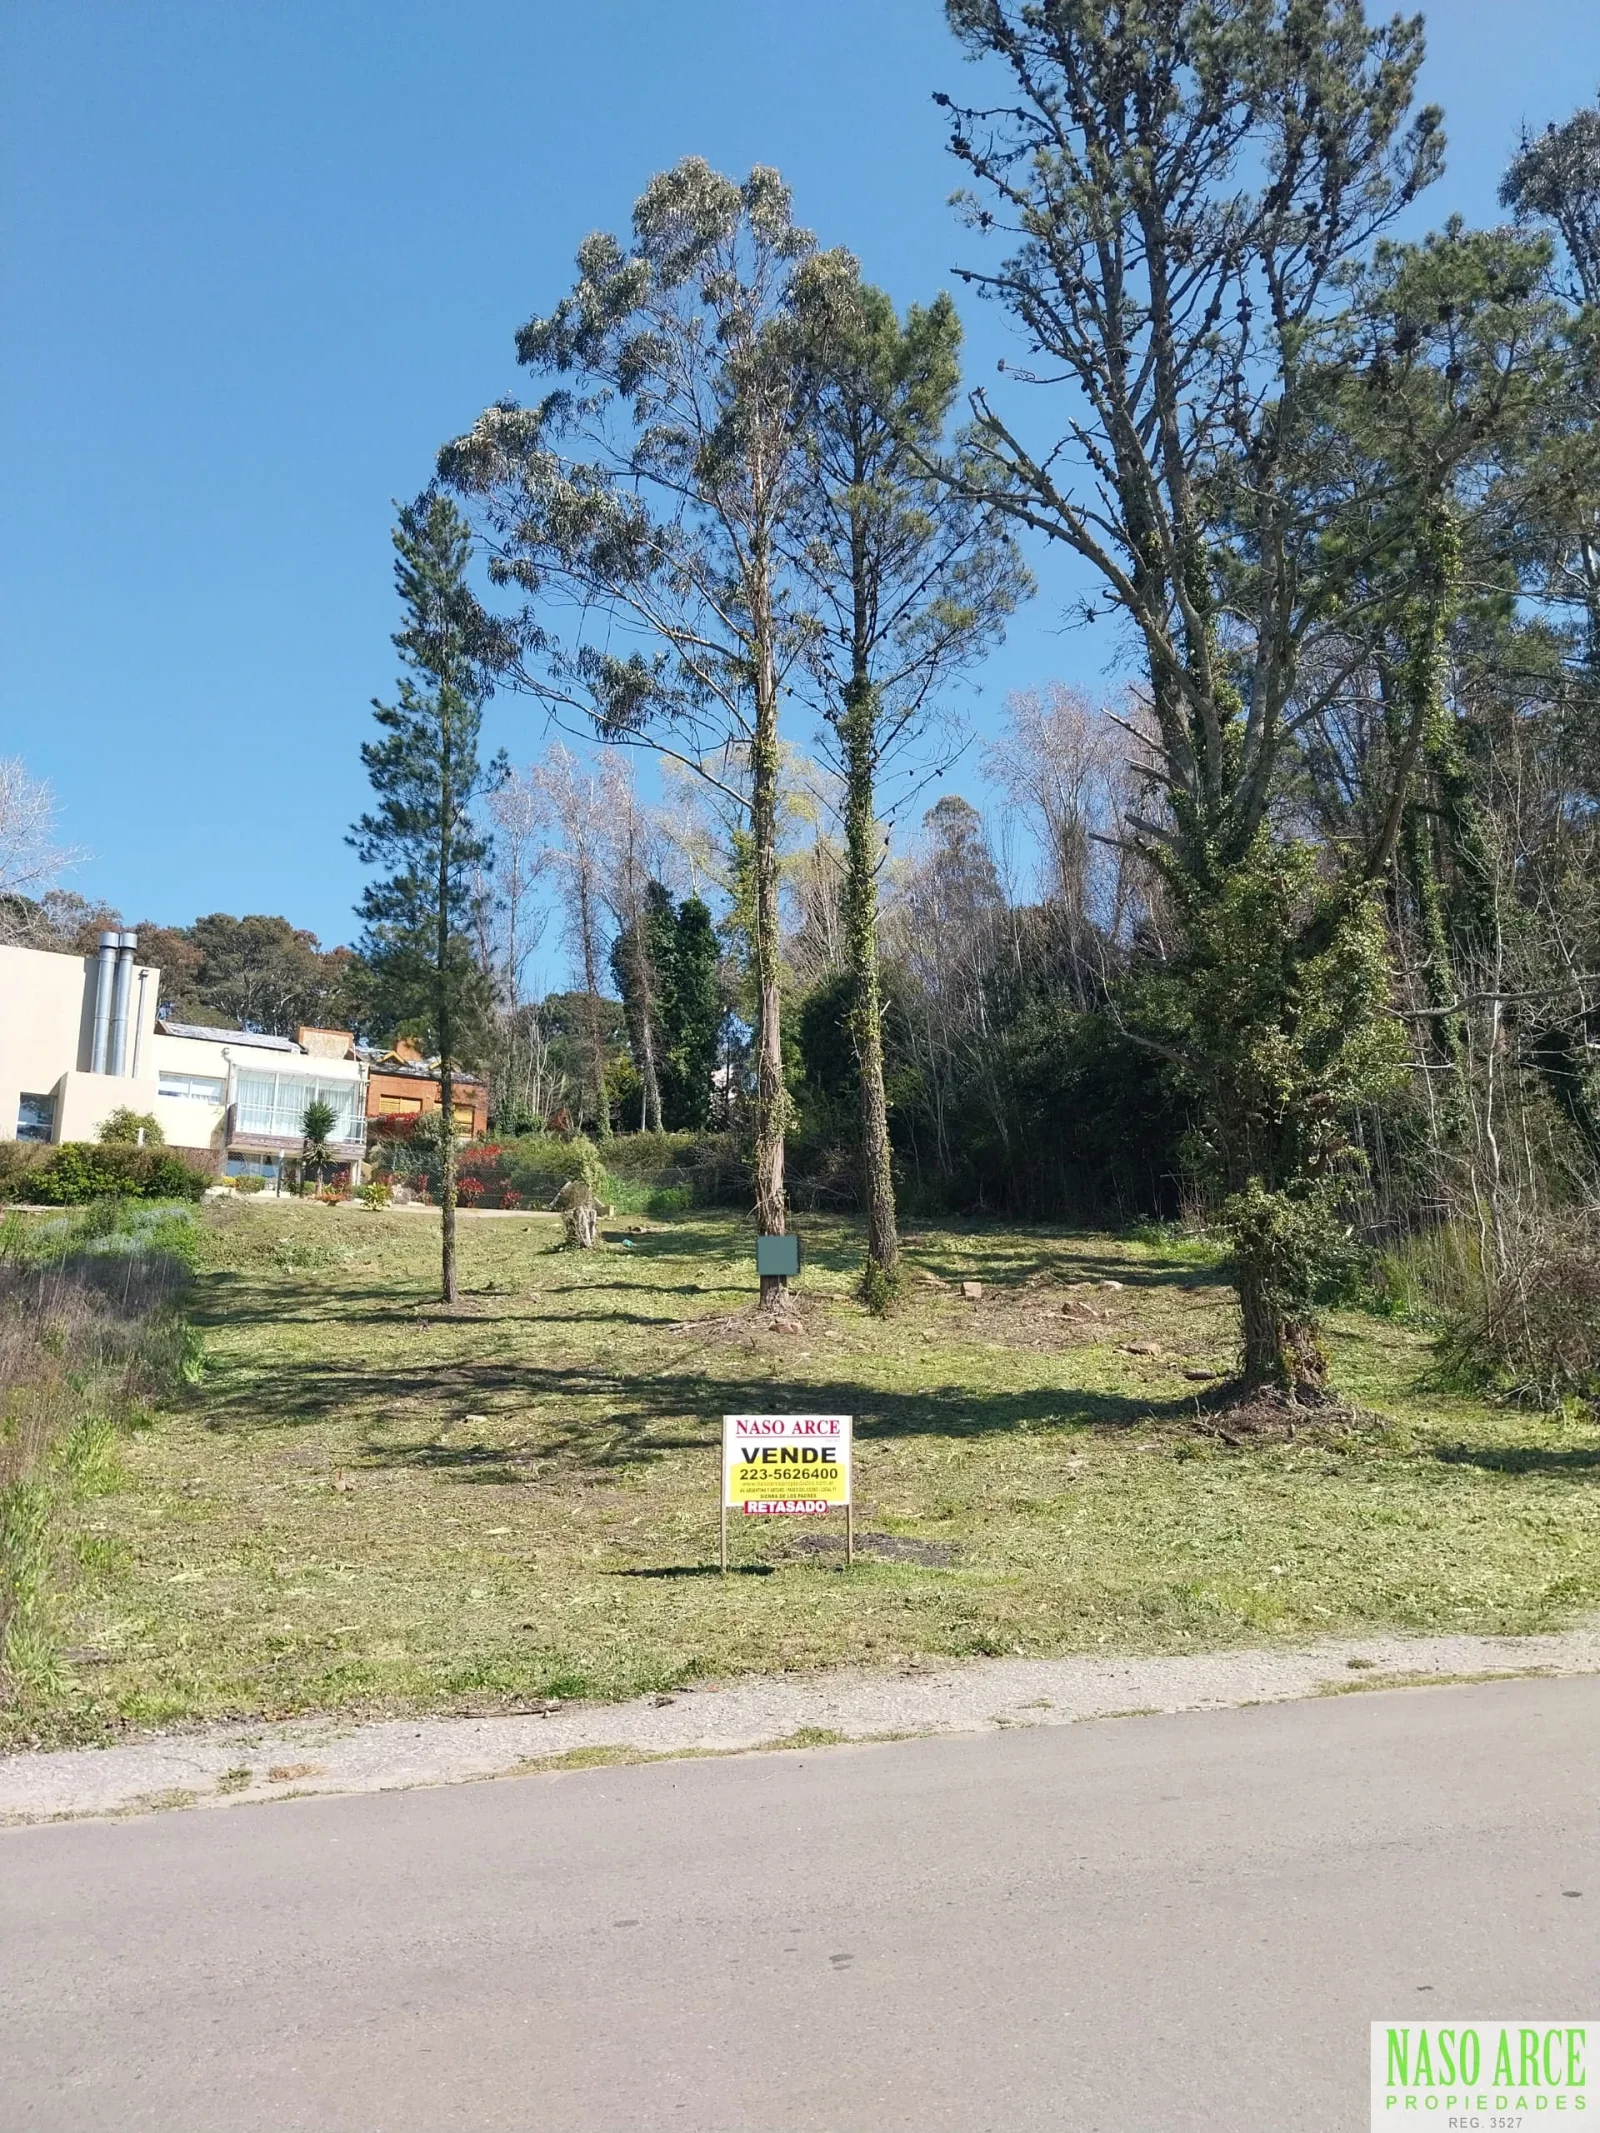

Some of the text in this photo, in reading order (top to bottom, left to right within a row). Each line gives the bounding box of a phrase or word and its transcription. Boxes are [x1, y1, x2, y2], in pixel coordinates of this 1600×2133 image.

[736, 1420, 840, 1434] NASO ARCE
[741, 1447, 837, 1464] VENDE
[740, 1468, 838, 1480] 223-5626400
[748, 1501, 826, 1513] RETASADO
